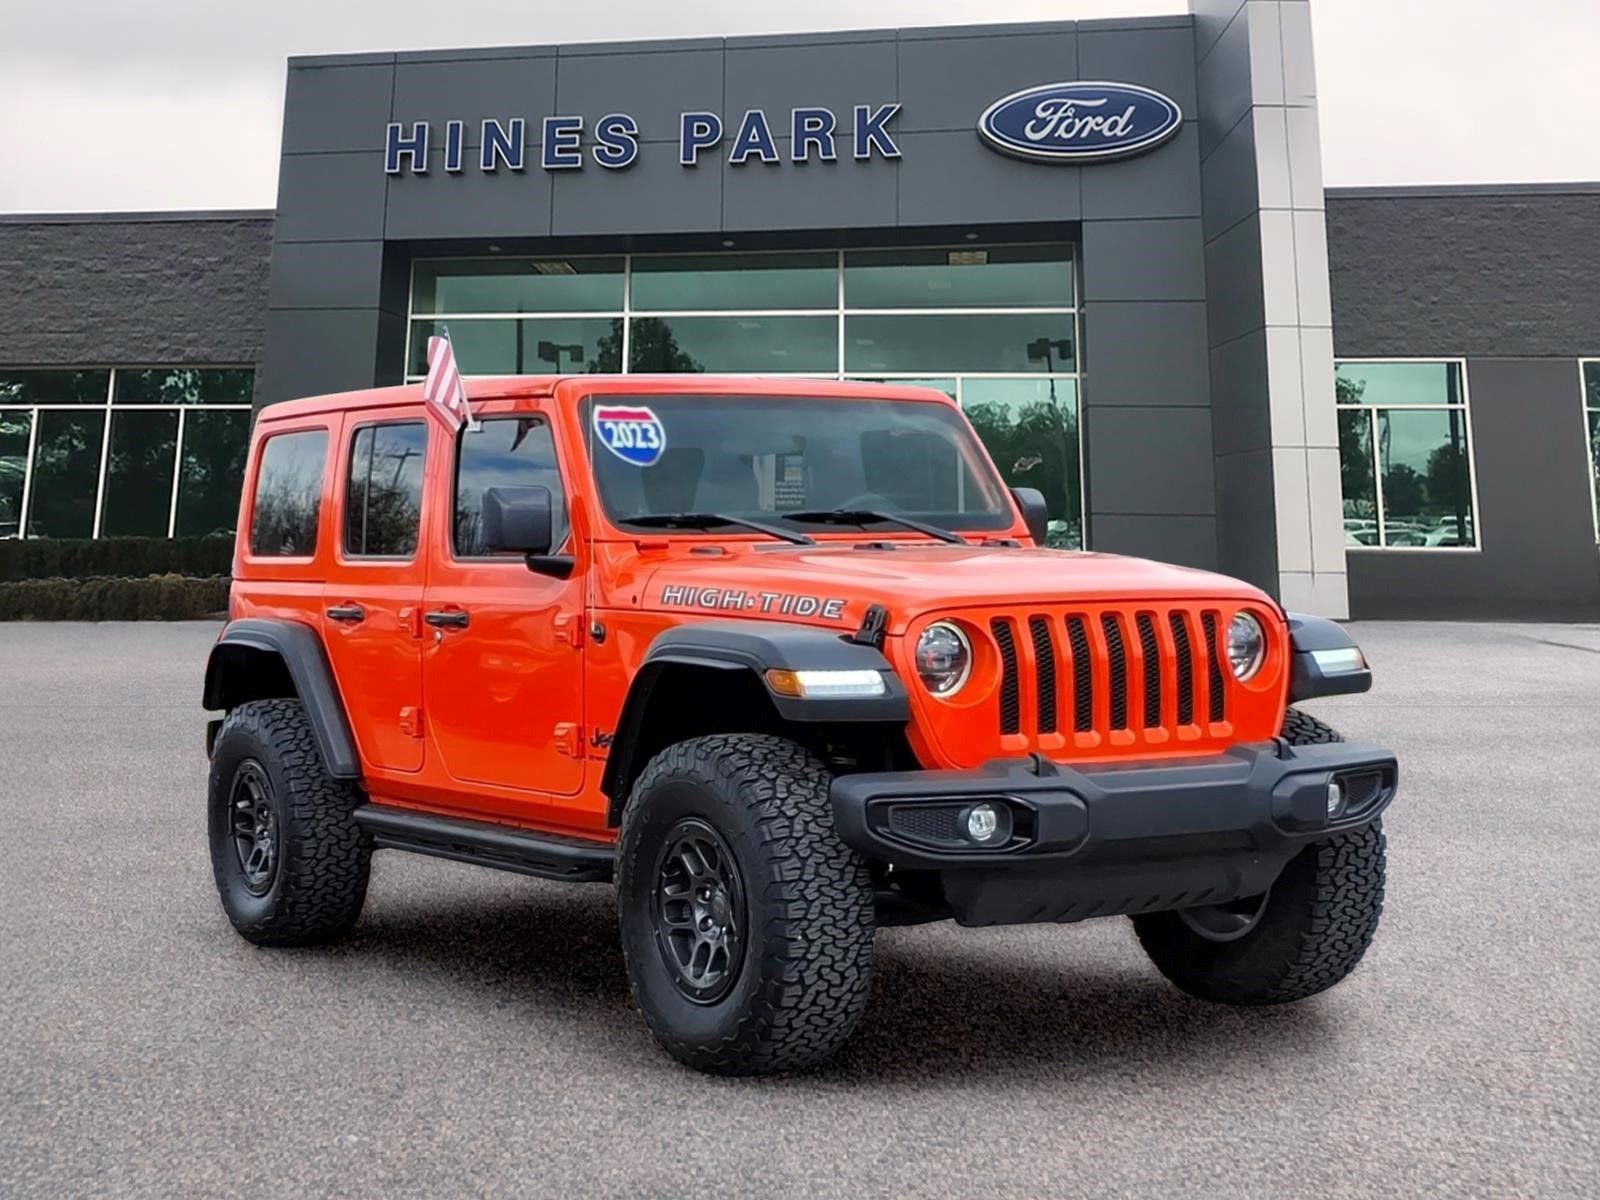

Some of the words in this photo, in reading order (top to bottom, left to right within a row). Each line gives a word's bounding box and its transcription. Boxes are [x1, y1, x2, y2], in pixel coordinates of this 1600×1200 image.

[385, 113, 638, 174] HINES
[679, 103, 902, 165] PARK
[1024, 98, 1136, 141] Ford
[605, 421, 661, 449] 2023
